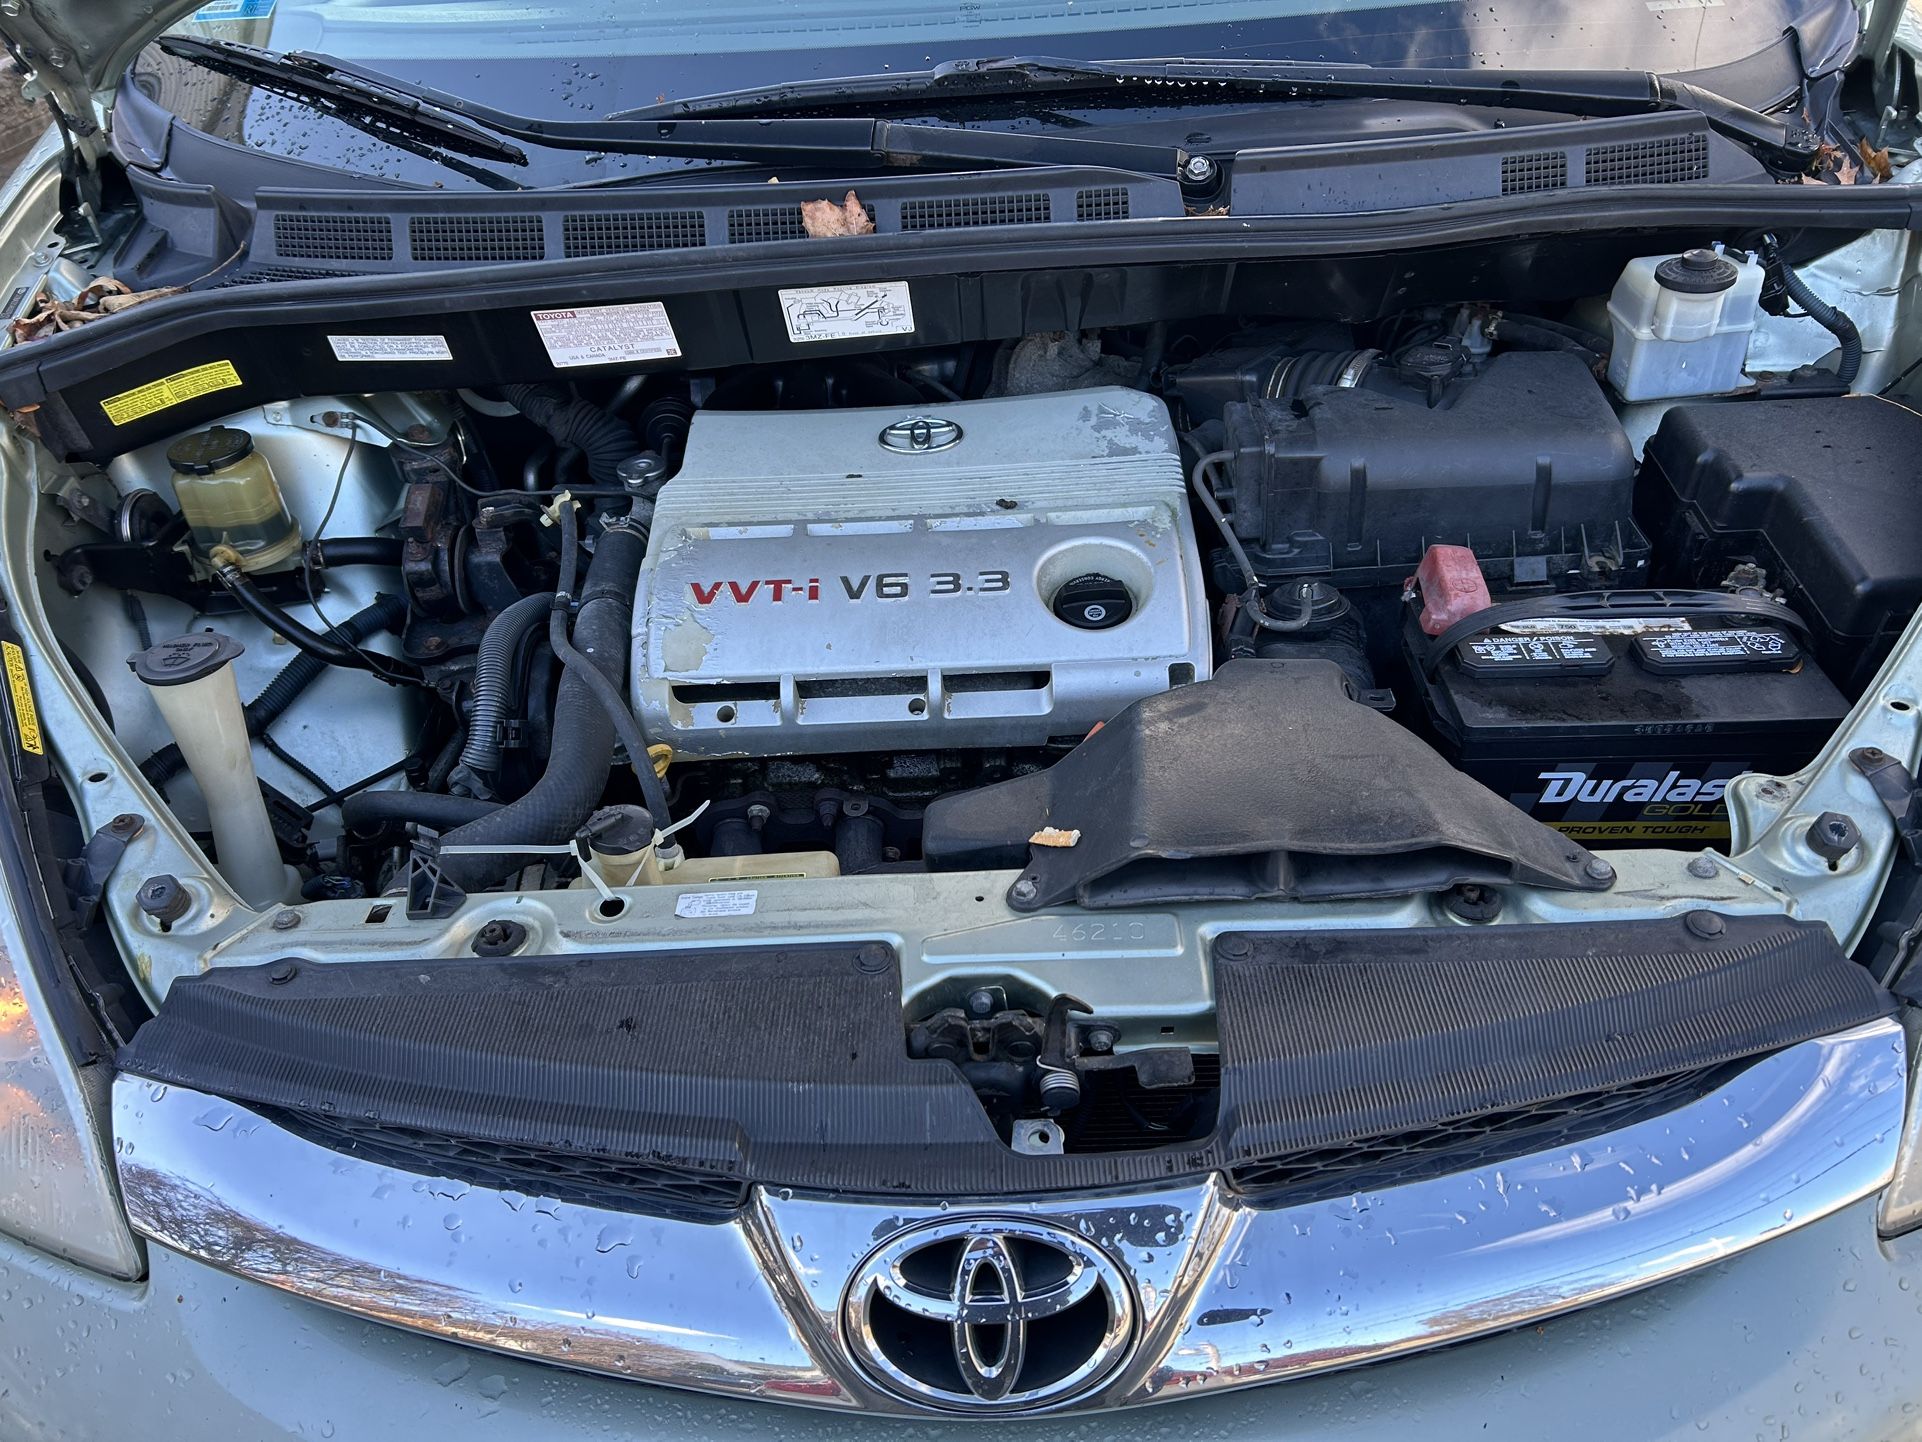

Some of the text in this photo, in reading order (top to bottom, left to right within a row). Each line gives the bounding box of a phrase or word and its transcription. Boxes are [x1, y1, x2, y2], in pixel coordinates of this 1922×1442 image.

[536, 310, 574, 320] TOYOTA
[589, 343, 635, 353] CATALYST
[690, 570, 1011, 606] VVT-i V6 3.3
[1539, 635, 1575, 643] POISON
[1538, 770, 1752, 804] Duralas
[1642, 803, 1727, 817] GOLD
[1557, 825, 1711, 835] PROVEN TOUGH
